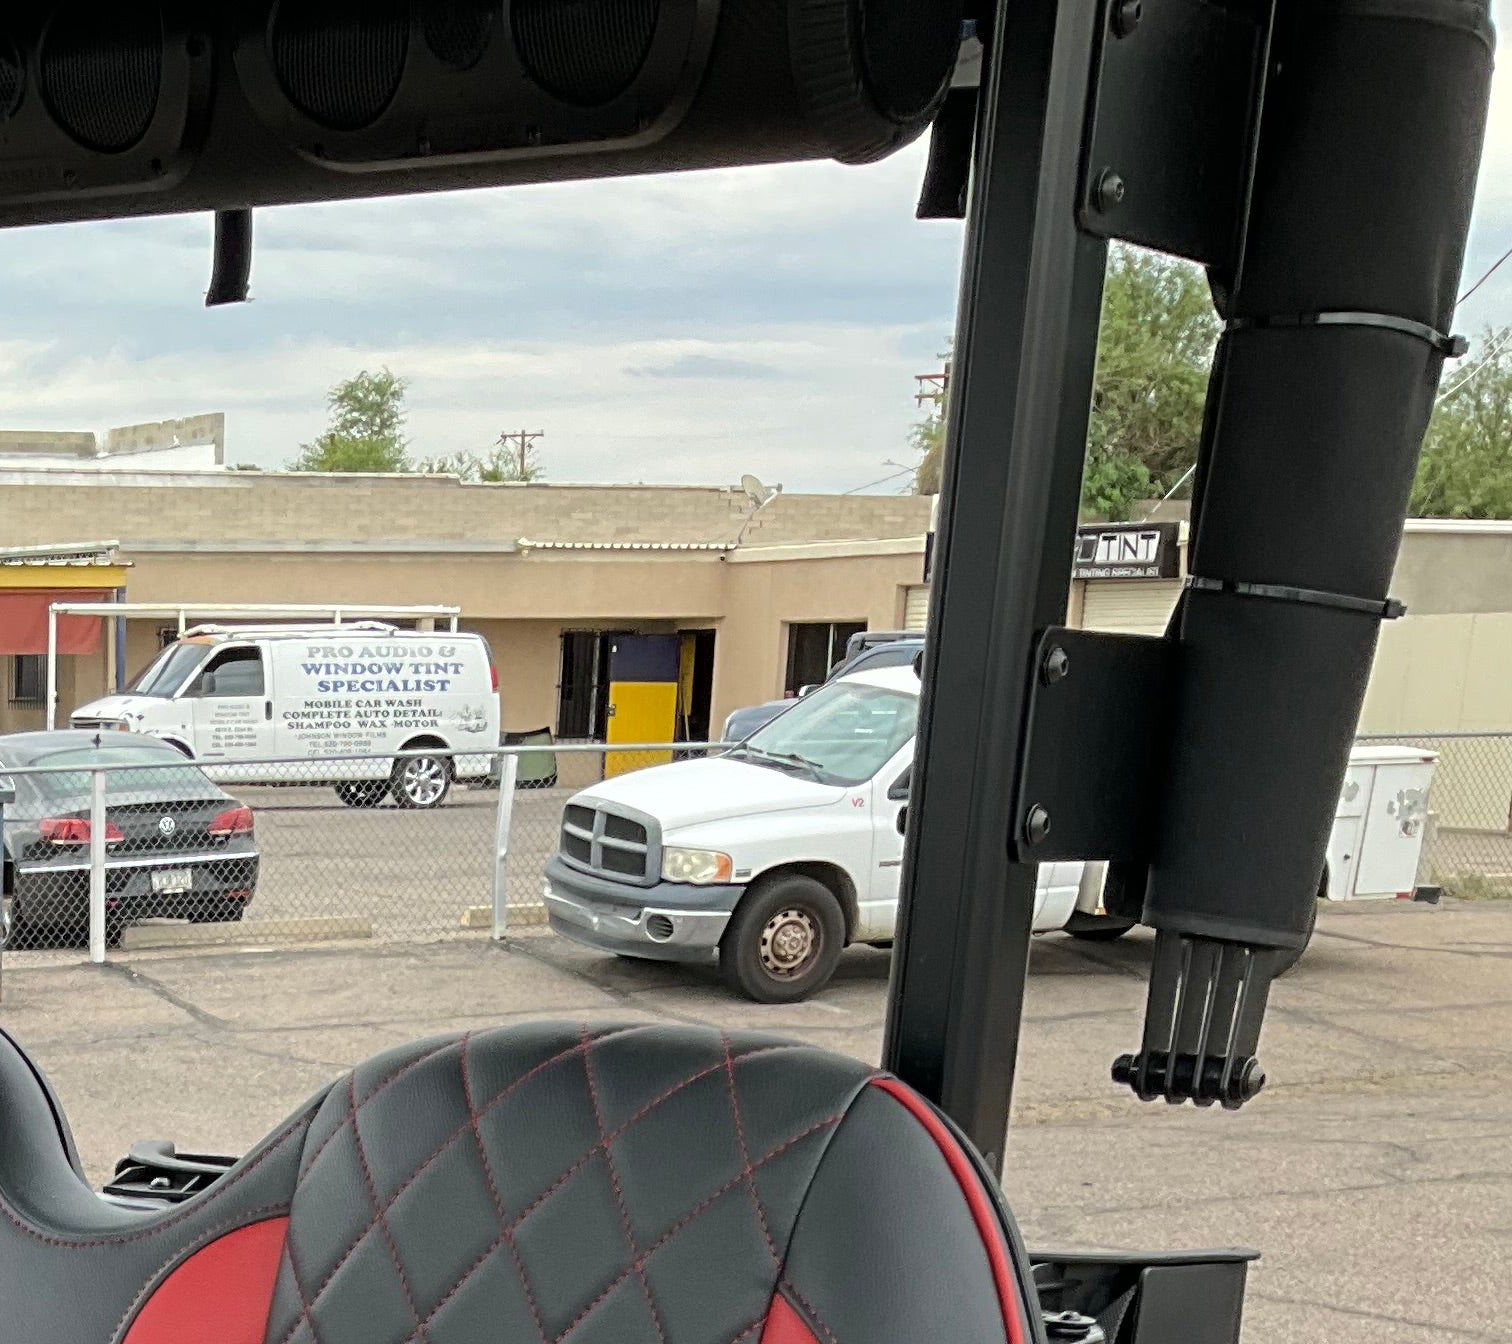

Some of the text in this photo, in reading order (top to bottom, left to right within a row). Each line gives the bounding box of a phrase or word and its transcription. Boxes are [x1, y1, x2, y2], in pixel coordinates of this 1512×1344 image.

[307, 646, 456, 658] PRO AUDIO &
[301, 662, 464, 676] WINDOW TINT
[317, 679, 451, 693] SPECIALIST
[304, 699, 422, 709] MOBILE CAR WASH
[282, 711, 351, 720] COMPLETE
[354, 710, 389, 719] AUTO
[287, 721, 351, 730] SHAMPOO
[357, 720, 387, 729] WAX
[852, 798, 864, 807] V2
